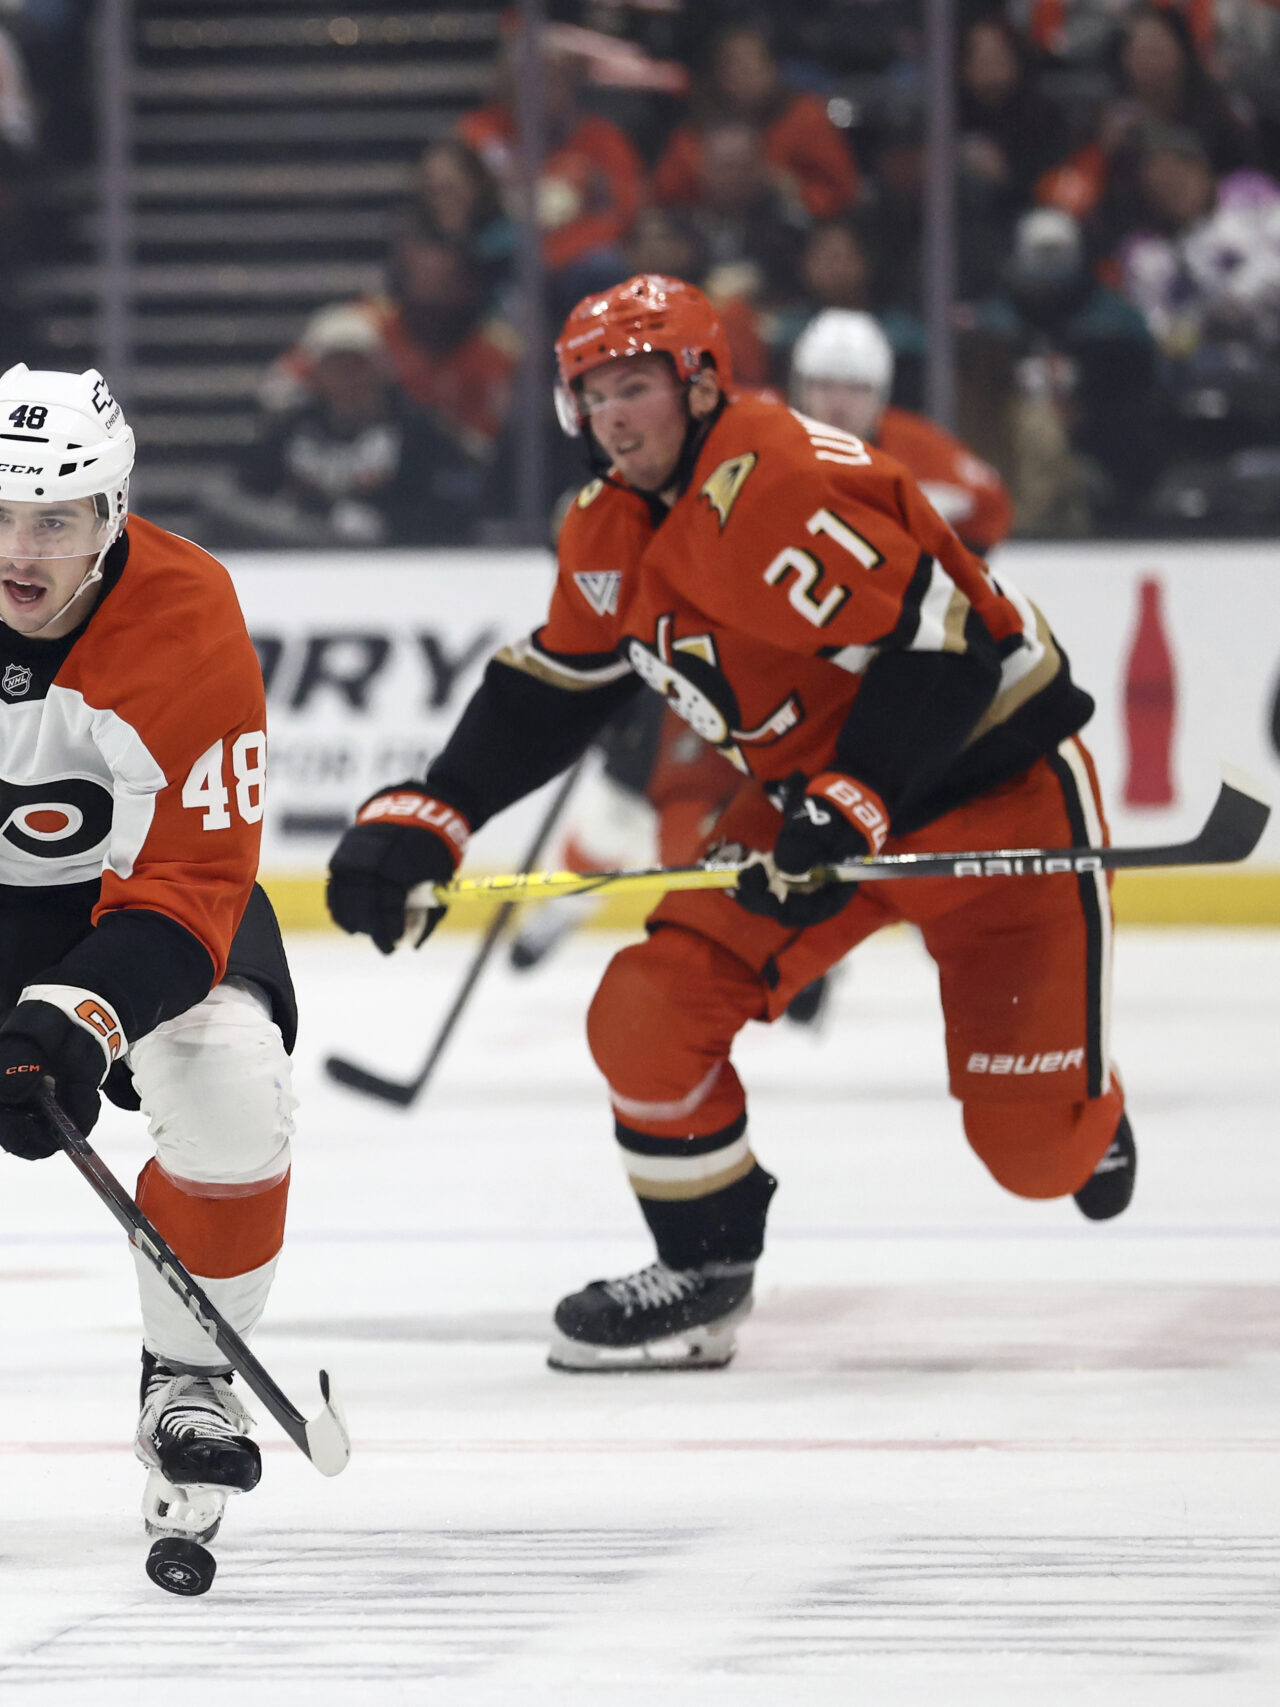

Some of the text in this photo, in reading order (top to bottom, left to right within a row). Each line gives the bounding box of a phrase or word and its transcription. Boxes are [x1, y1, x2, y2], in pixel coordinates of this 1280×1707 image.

[8, 404, 48, 430] 48
[763, 508, 886, 628] 21
[7, 674, 26, 688] NHL
[182, 729, 267, 831] 48
[5, 1065, 41, 1075] CCM
